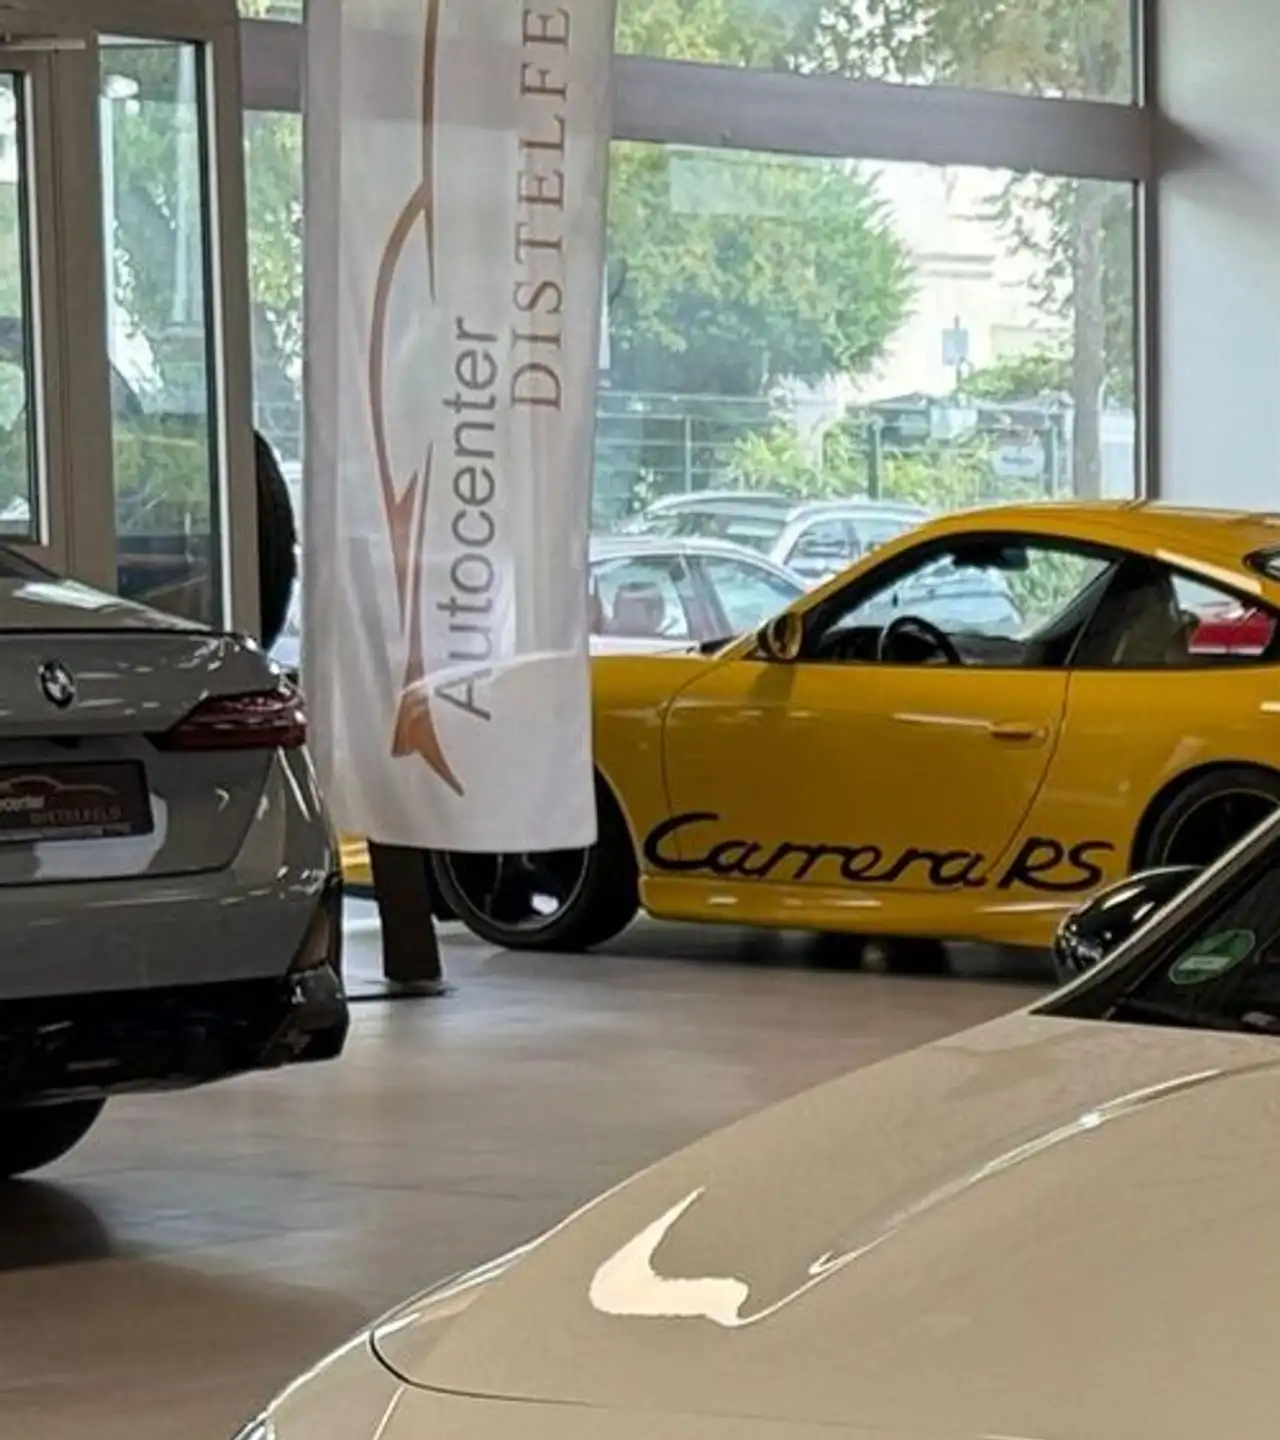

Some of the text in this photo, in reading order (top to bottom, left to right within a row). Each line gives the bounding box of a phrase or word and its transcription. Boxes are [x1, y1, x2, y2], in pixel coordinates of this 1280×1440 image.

[435, 316, 499, 722] Autocenter
[643, 811, 1115, 892] Carrera RS
